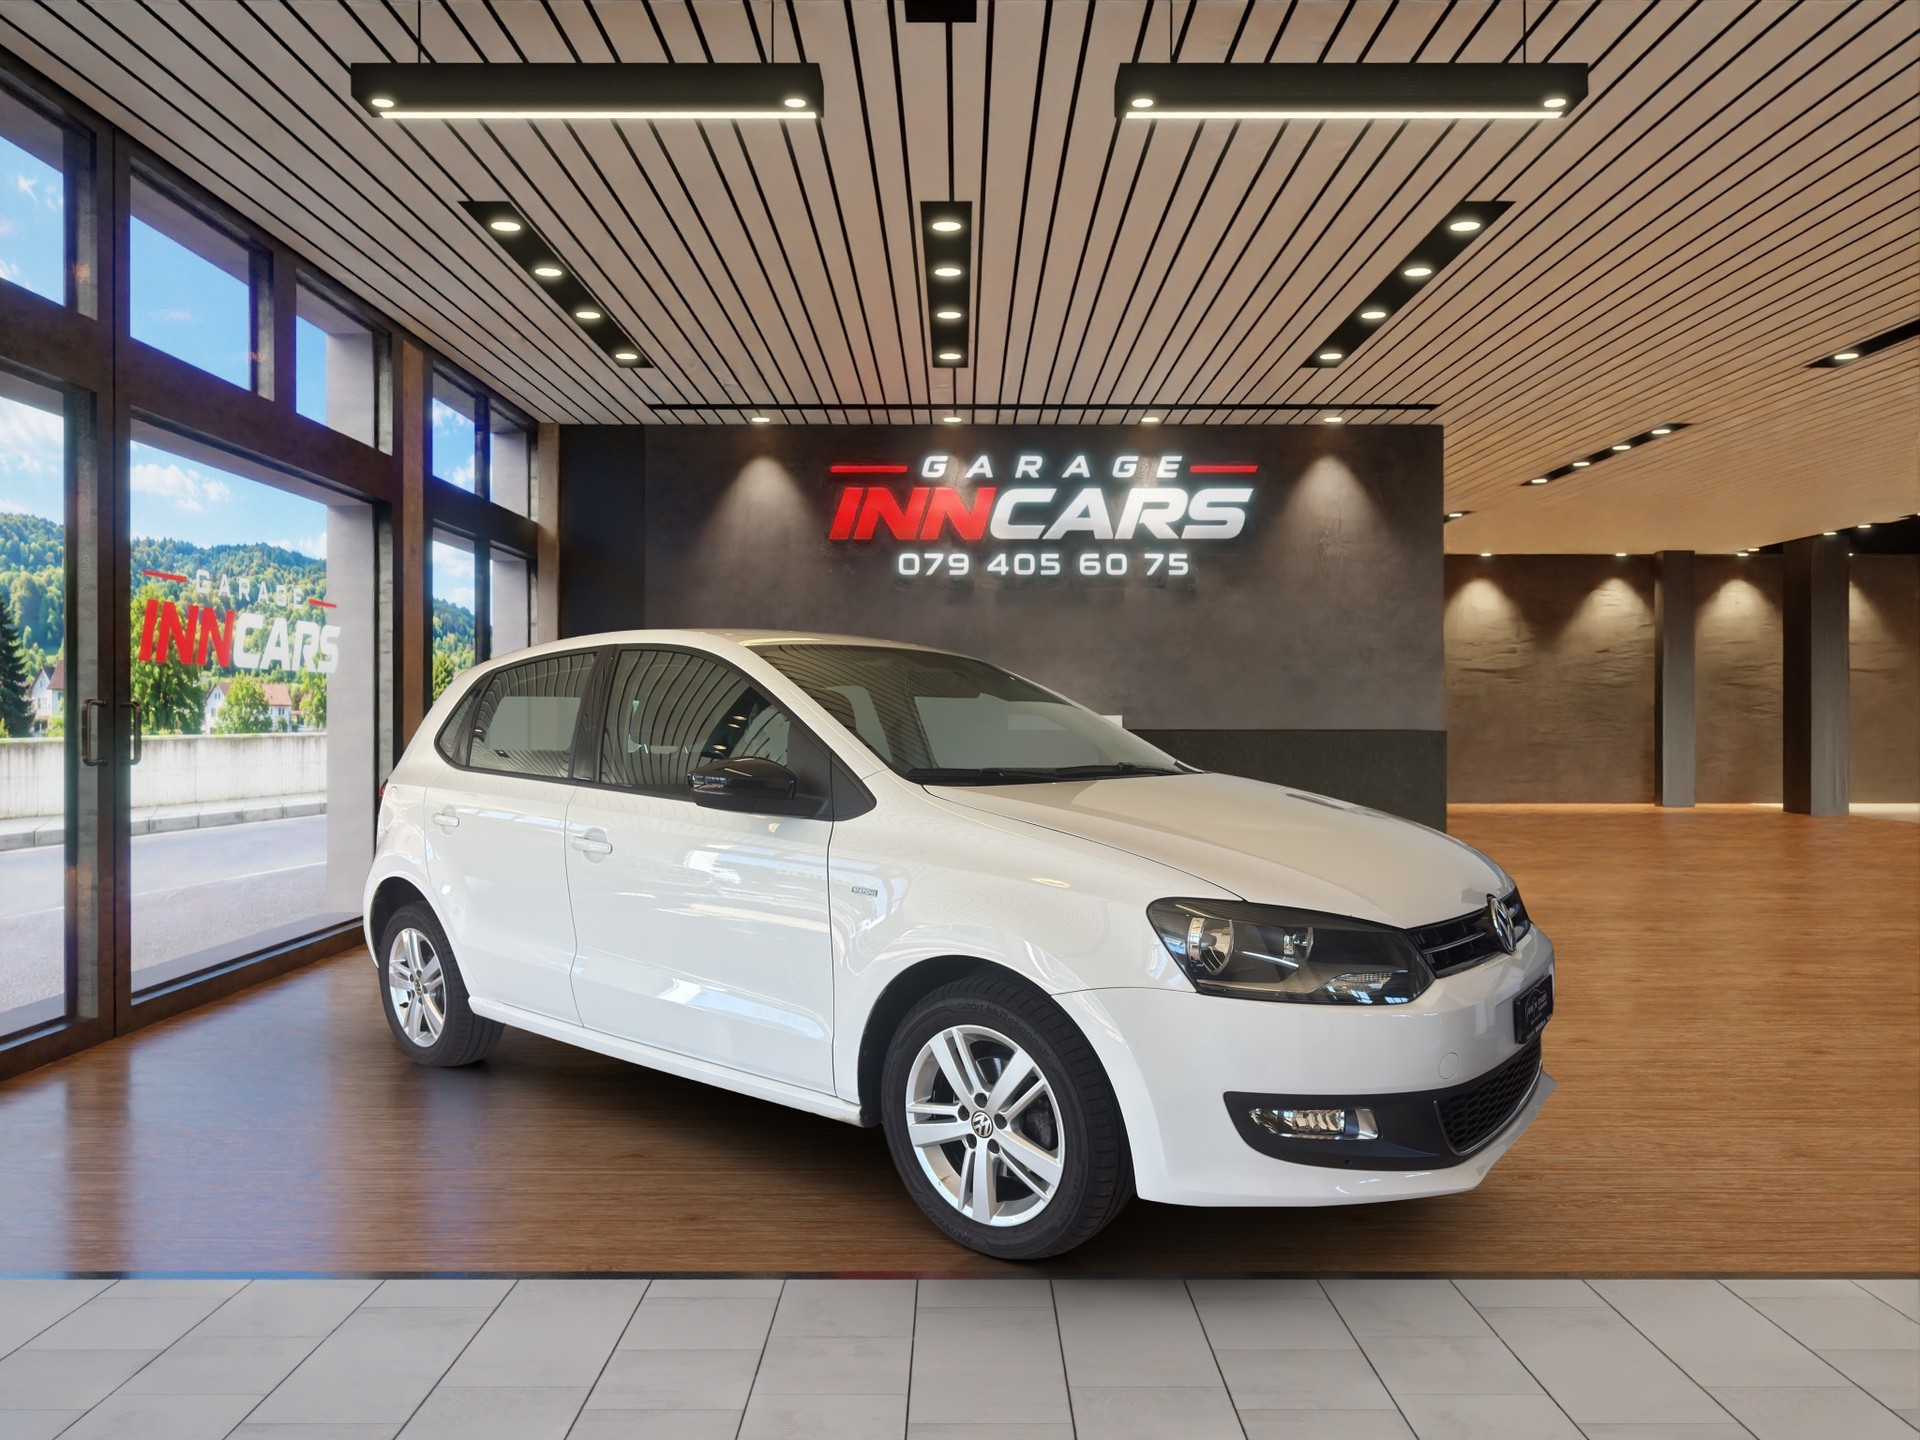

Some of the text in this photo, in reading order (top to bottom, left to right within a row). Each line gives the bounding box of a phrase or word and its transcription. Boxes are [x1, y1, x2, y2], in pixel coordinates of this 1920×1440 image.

[921, 455, 1183, 479] GARAGE
[829, 486, 1255, 540] INNCARS
[898, 553, 1189, 576] 079 405 60 75
[195, 568, 305, 610] GARAGE
[138, 598, 342, 674] INNCARS
